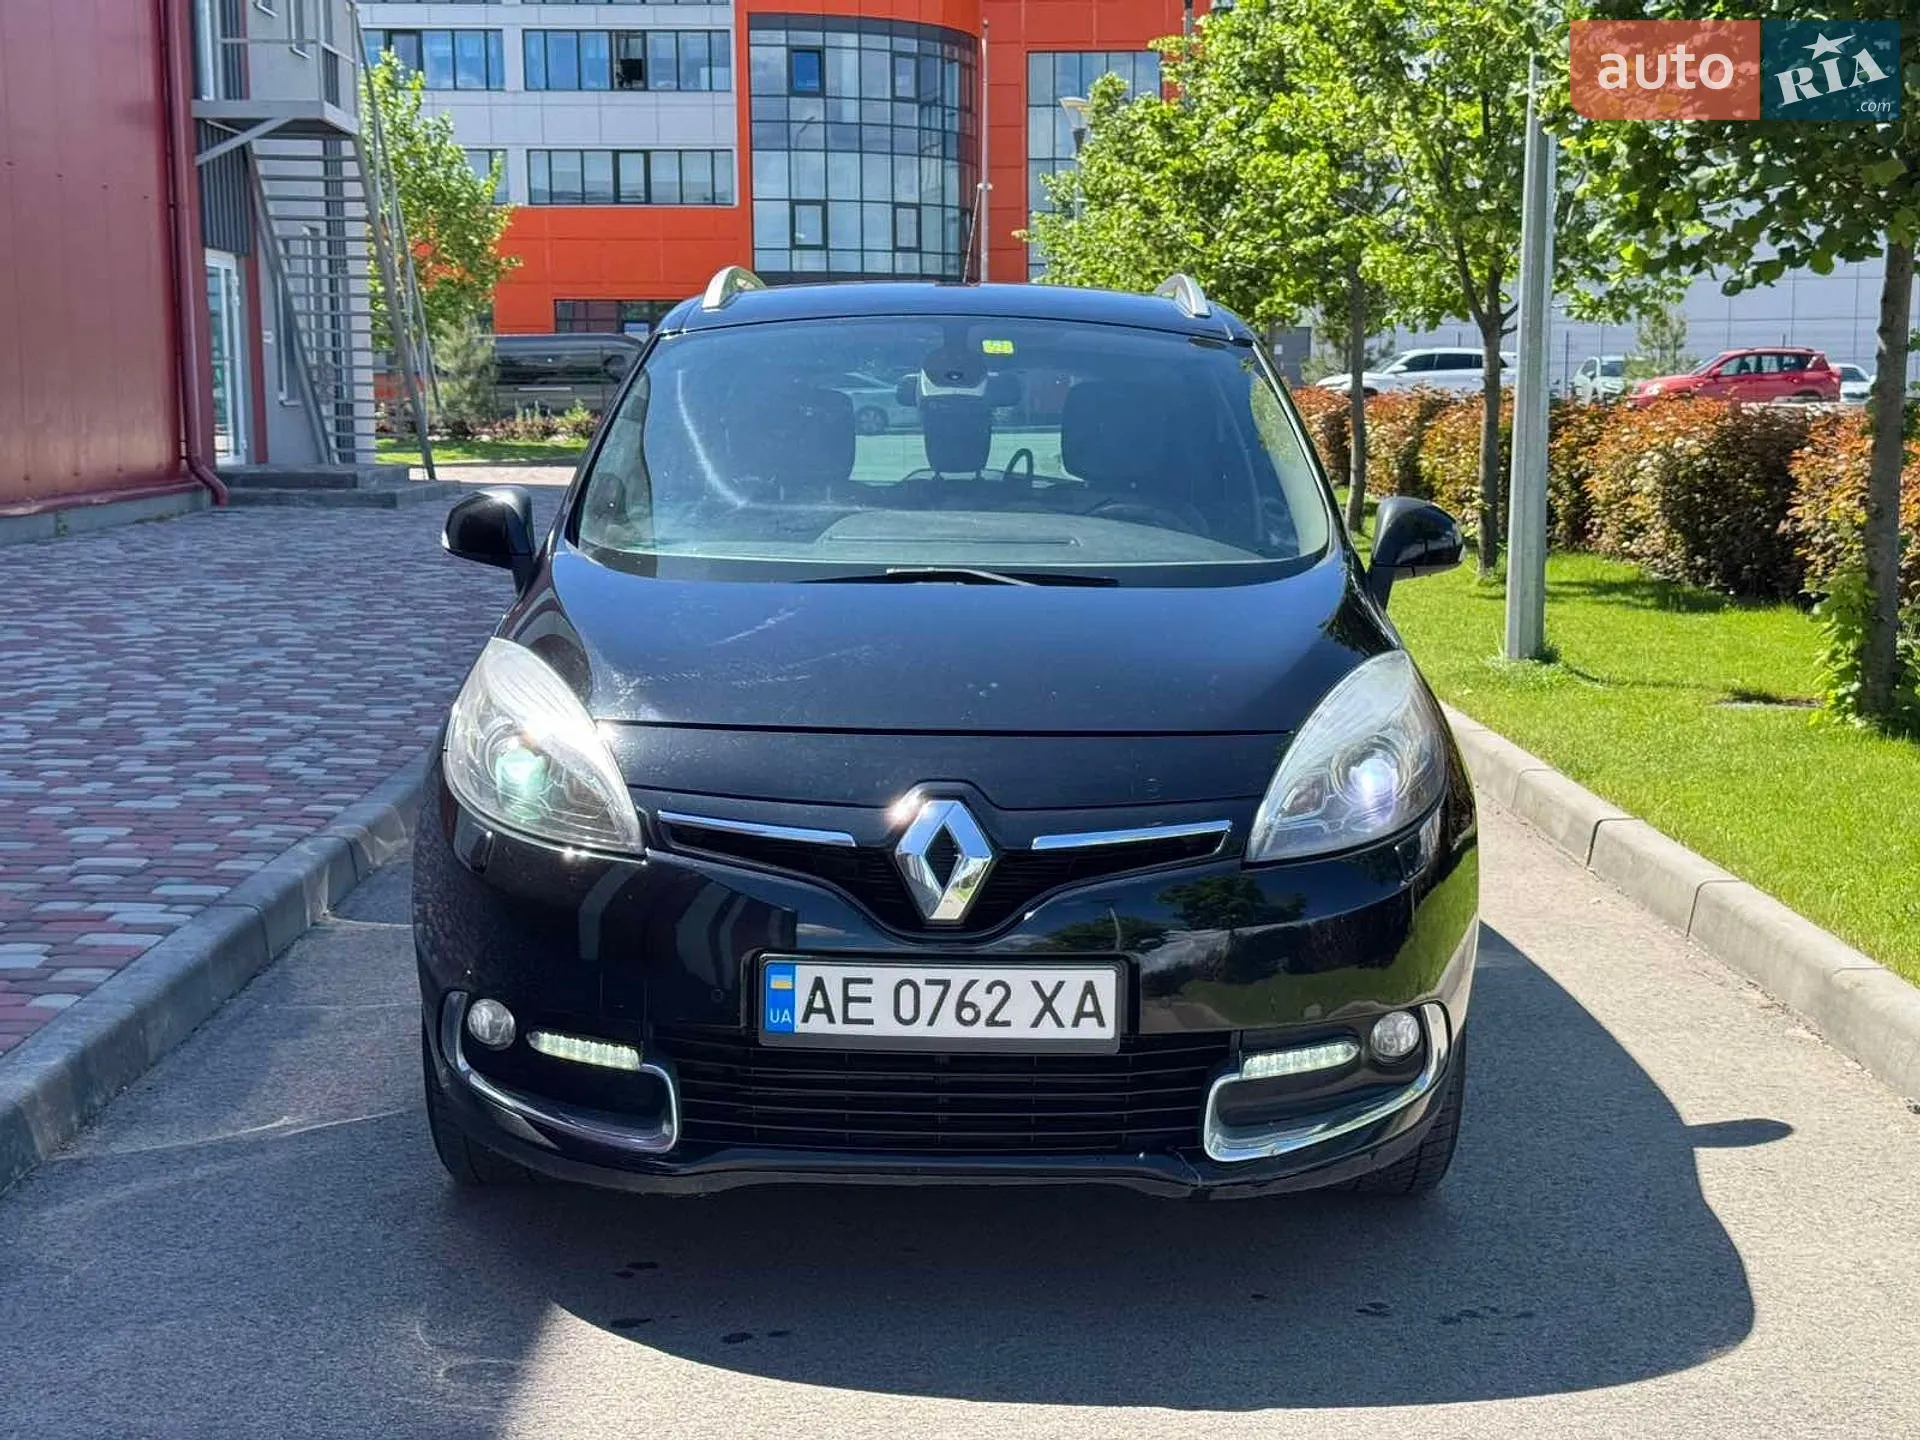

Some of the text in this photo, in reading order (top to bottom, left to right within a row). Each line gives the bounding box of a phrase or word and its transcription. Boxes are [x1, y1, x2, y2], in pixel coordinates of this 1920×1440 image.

[770, 1008, 792, 1024] UA
[801, 976, 1106, 1028] AE 0762 XA
